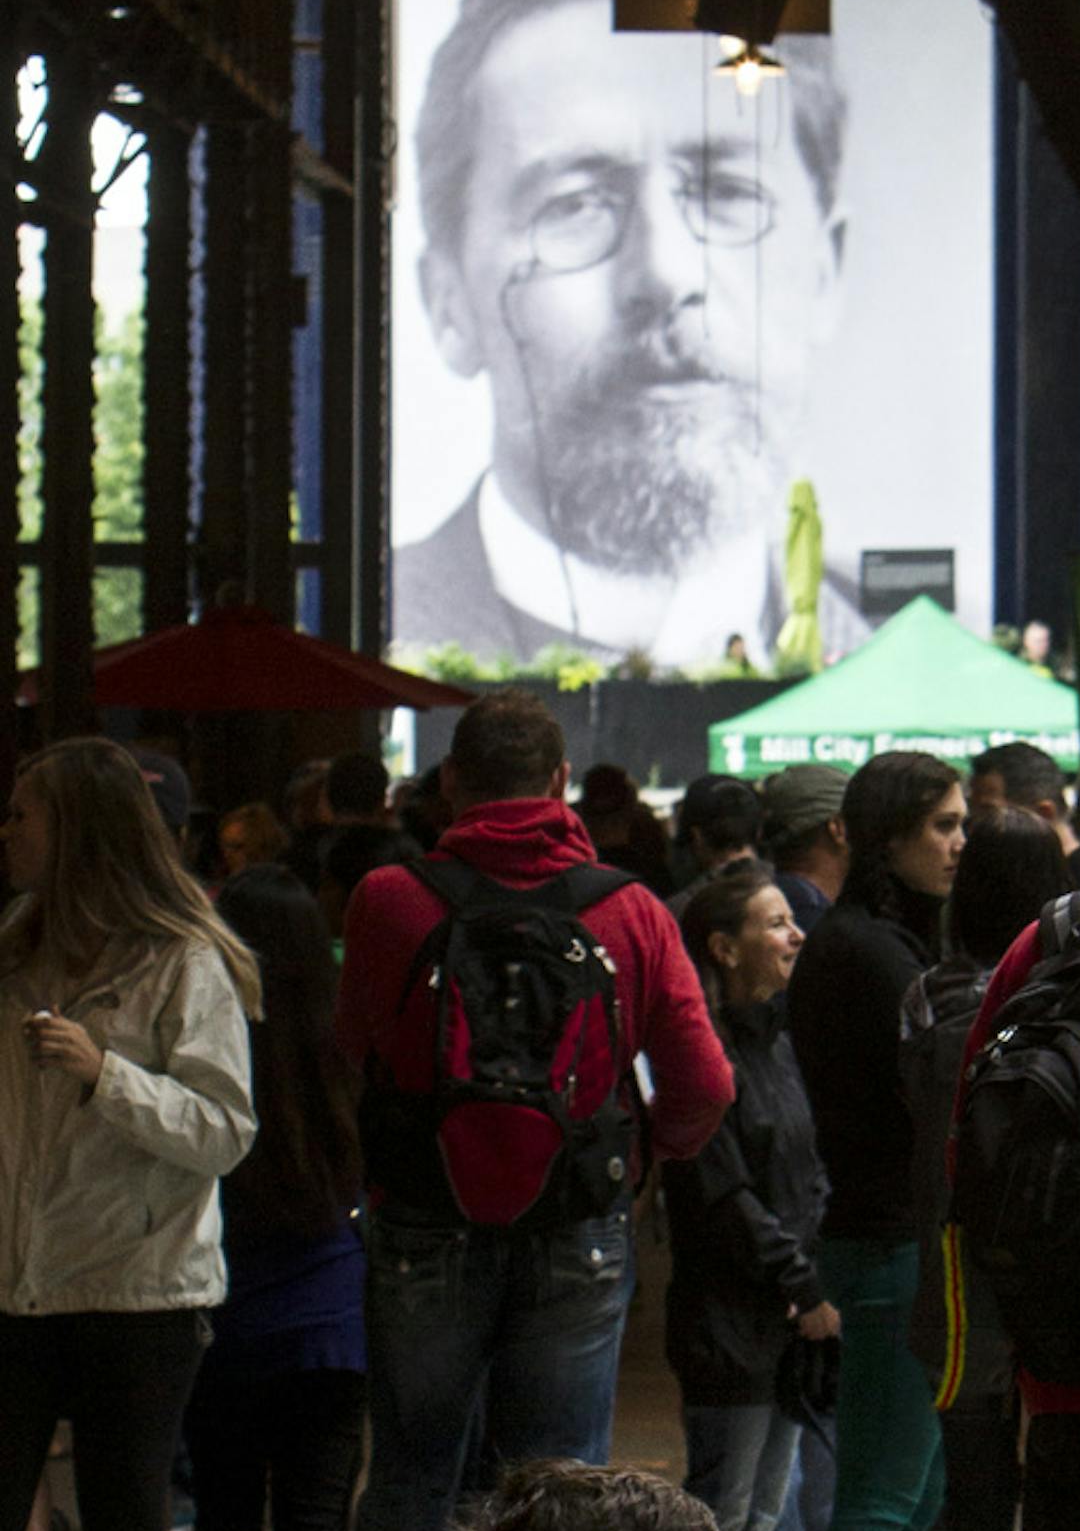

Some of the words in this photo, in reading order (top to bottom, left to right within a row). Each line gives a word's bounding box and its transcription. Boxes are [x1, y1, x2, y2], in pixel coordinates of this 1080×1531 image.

[760, 736, 811, 762] Mill
[814, 733, 870, 767] City
[989, 729, 1080, 756] Mket
